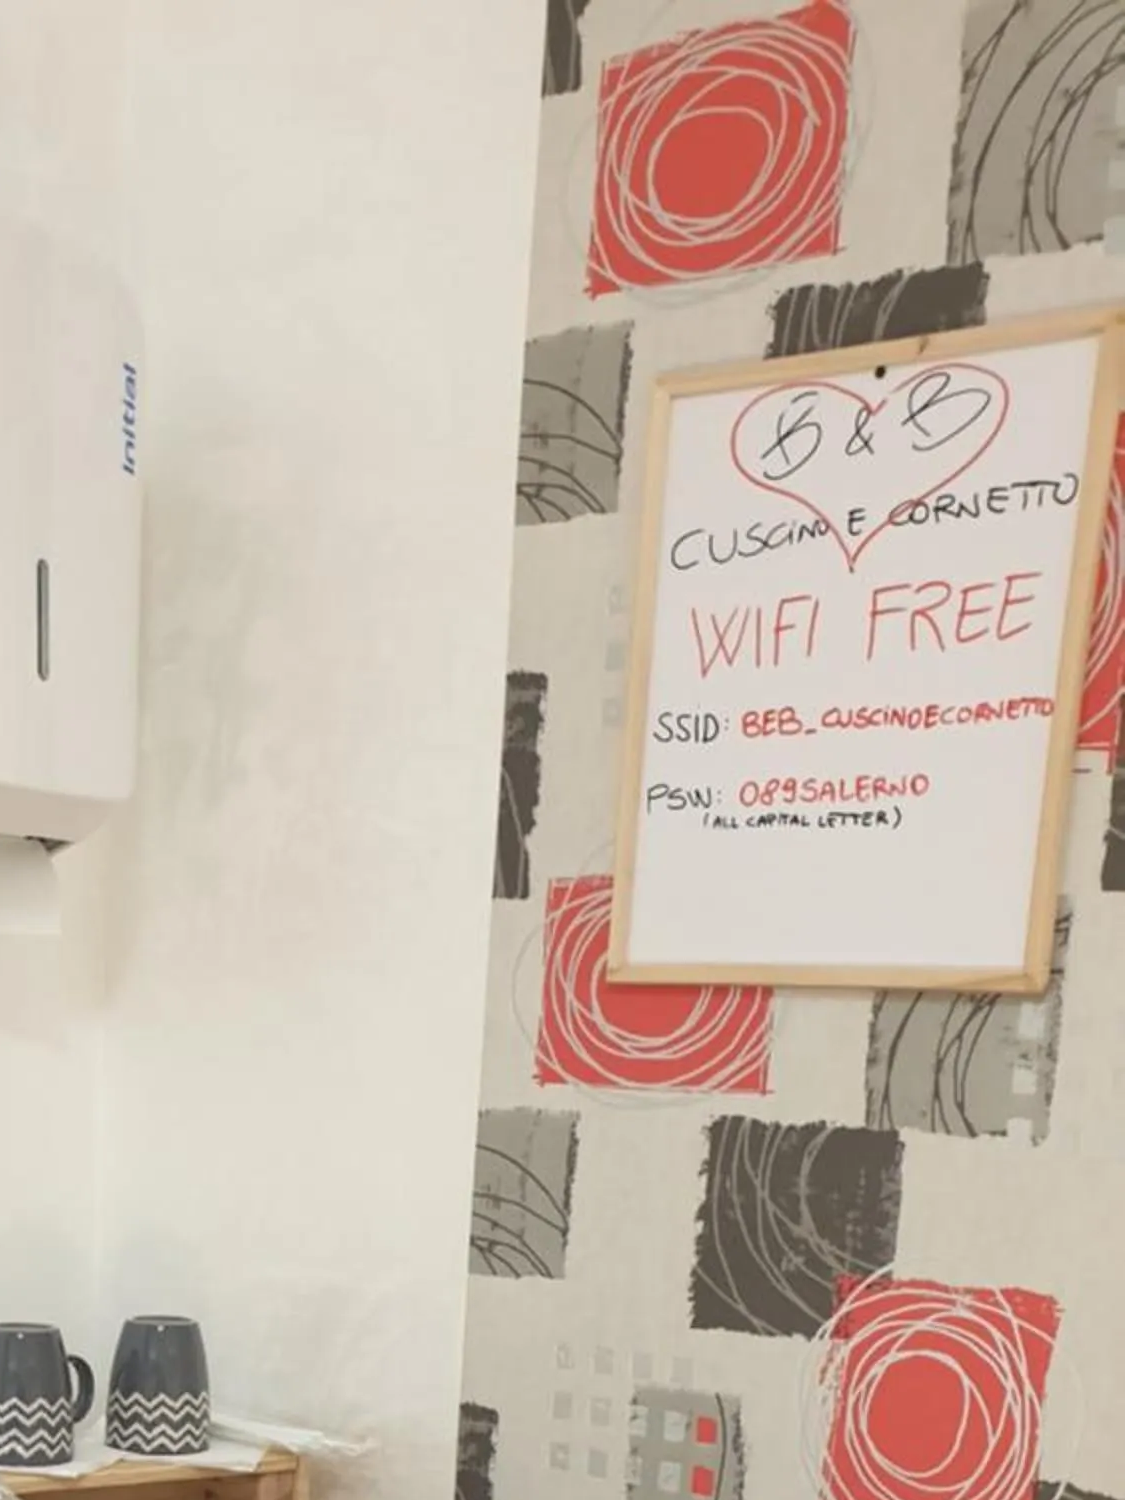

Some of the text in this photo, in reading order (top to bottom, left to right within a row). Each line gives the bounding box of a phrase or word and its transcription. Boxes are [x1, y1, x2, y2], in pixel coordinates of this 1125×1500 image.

[122, 362, 137, 475] Initial
[845, 404, 875, 456] &
[847, 508, 867, 537] E
[887, 473, 1079, 527] CORNETTO
[691, 572, 1042, 679] WIFI FREE
[653, 710, 729, 745] SSID:
[646, 774, 930, 814] PSW: 089SALERNO
[745, 811, 811, 829] CAPITAL
